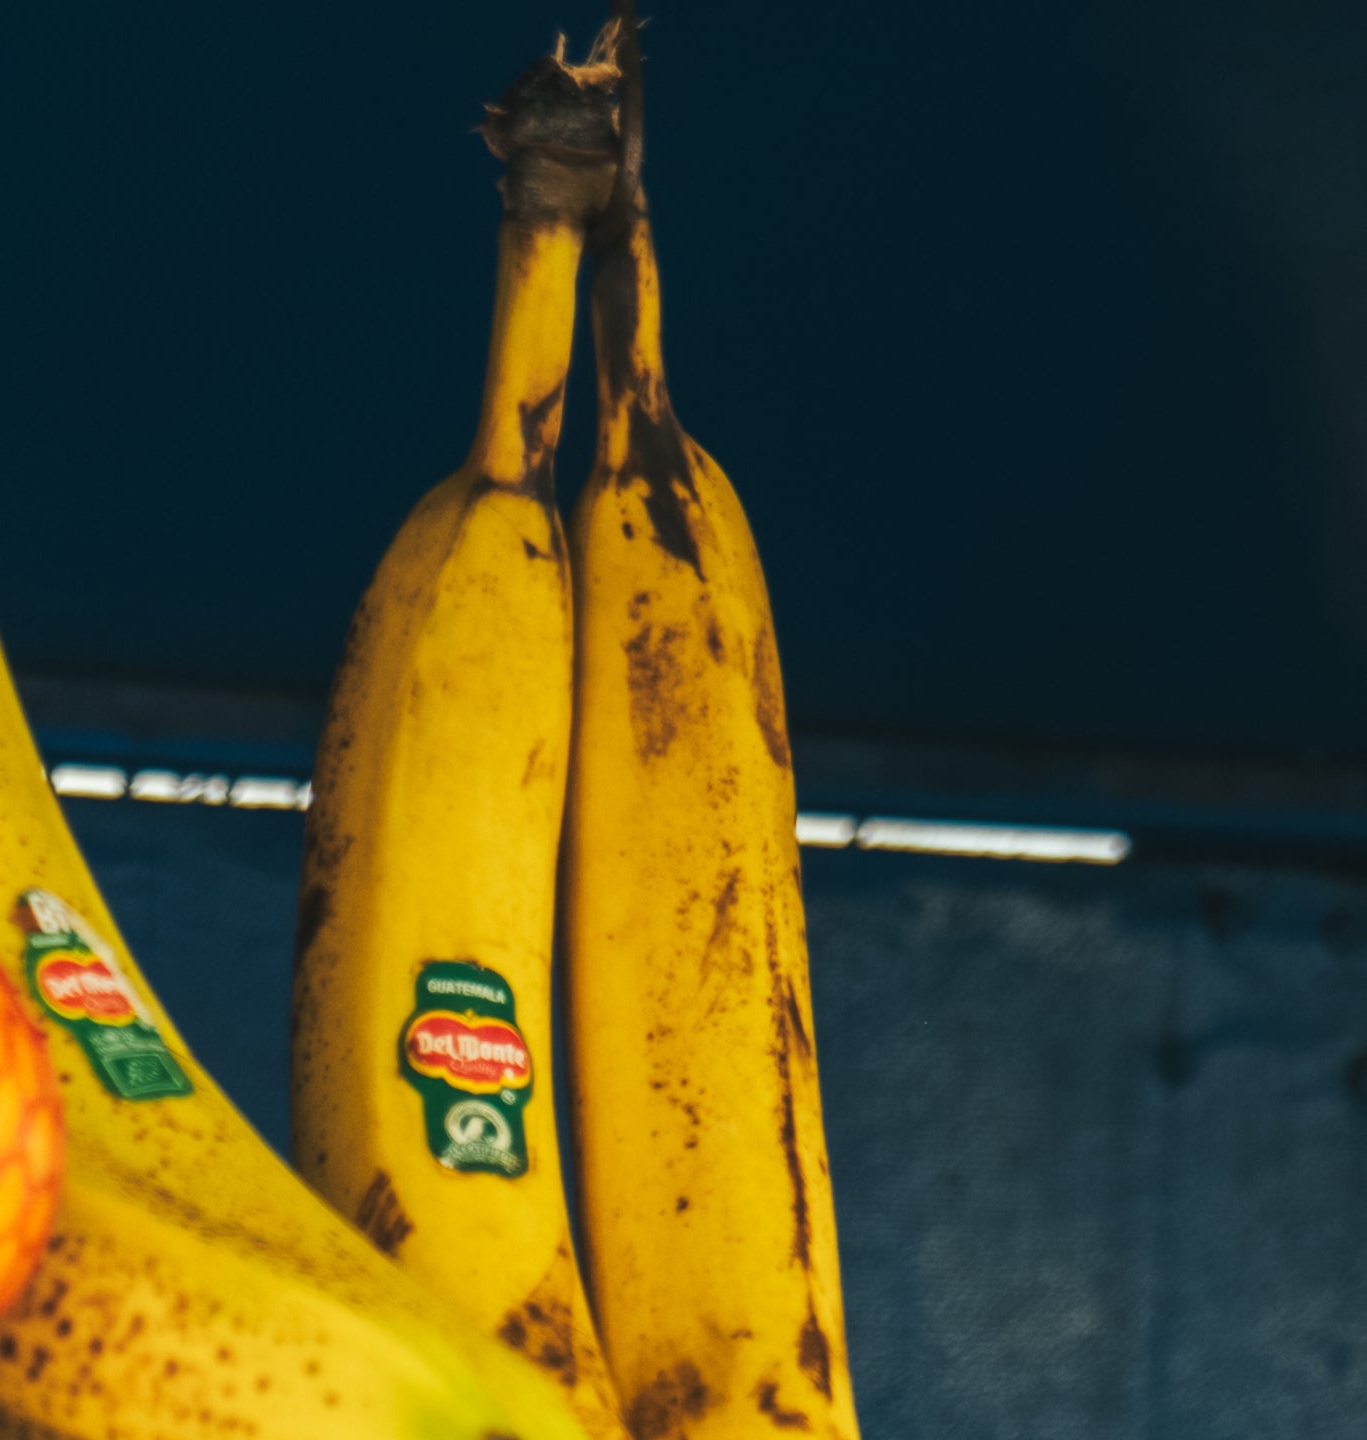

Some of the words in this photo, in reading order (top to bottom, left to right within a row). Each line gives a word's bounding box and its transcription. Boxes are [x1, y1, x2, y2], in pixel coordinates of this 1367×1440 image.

[427, 979, 505, 1005] GUATEMALA
[417, 1031, 463, 1064] Del
[457, 1034, 526, 1069] Monte
